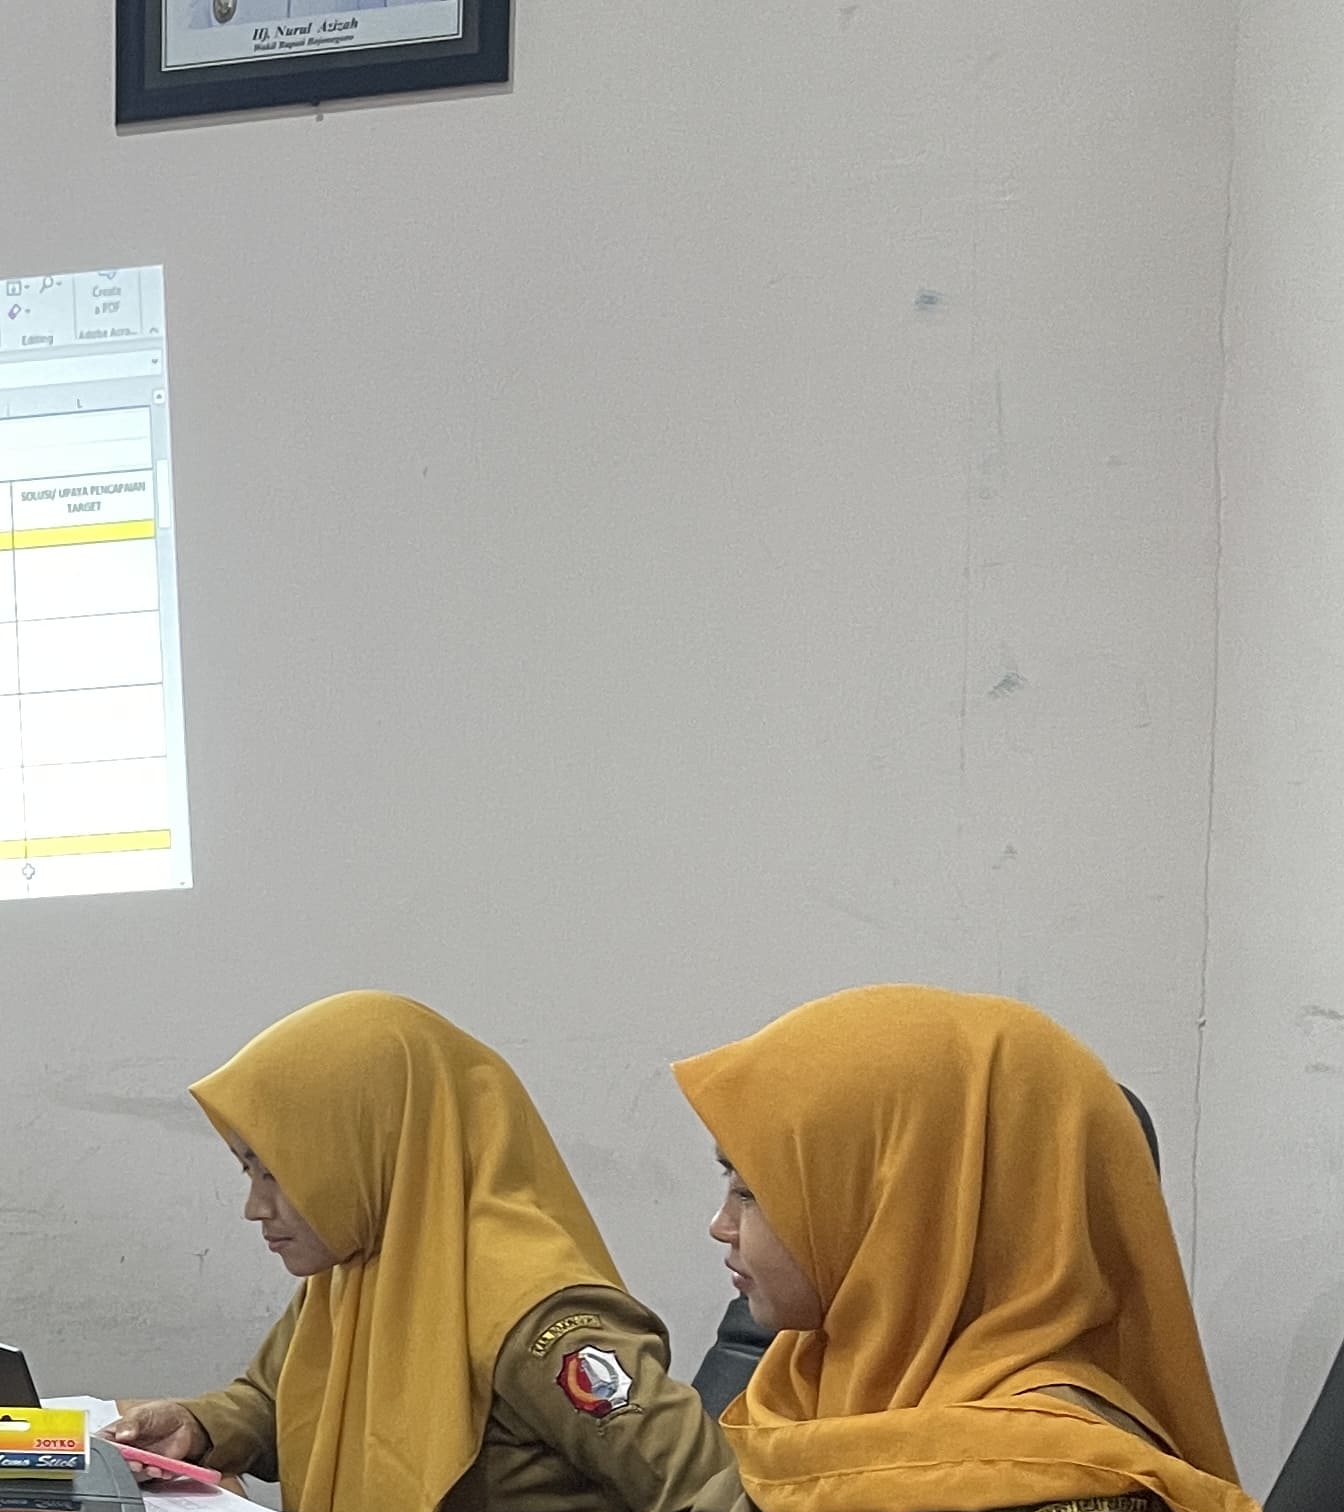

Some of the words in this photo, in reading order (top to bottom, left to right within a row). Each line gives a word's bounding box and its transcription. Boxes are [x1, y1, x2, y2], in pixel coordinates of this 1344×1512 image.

[275, 22, 312, 38] Nurul
[59, 486, 88, 498] UPAYA
[67, 501, 101, 513] TARGET
[35, 1439, 76, 1448] JOYKO
[35, 1455, 78, 1468] Stick
